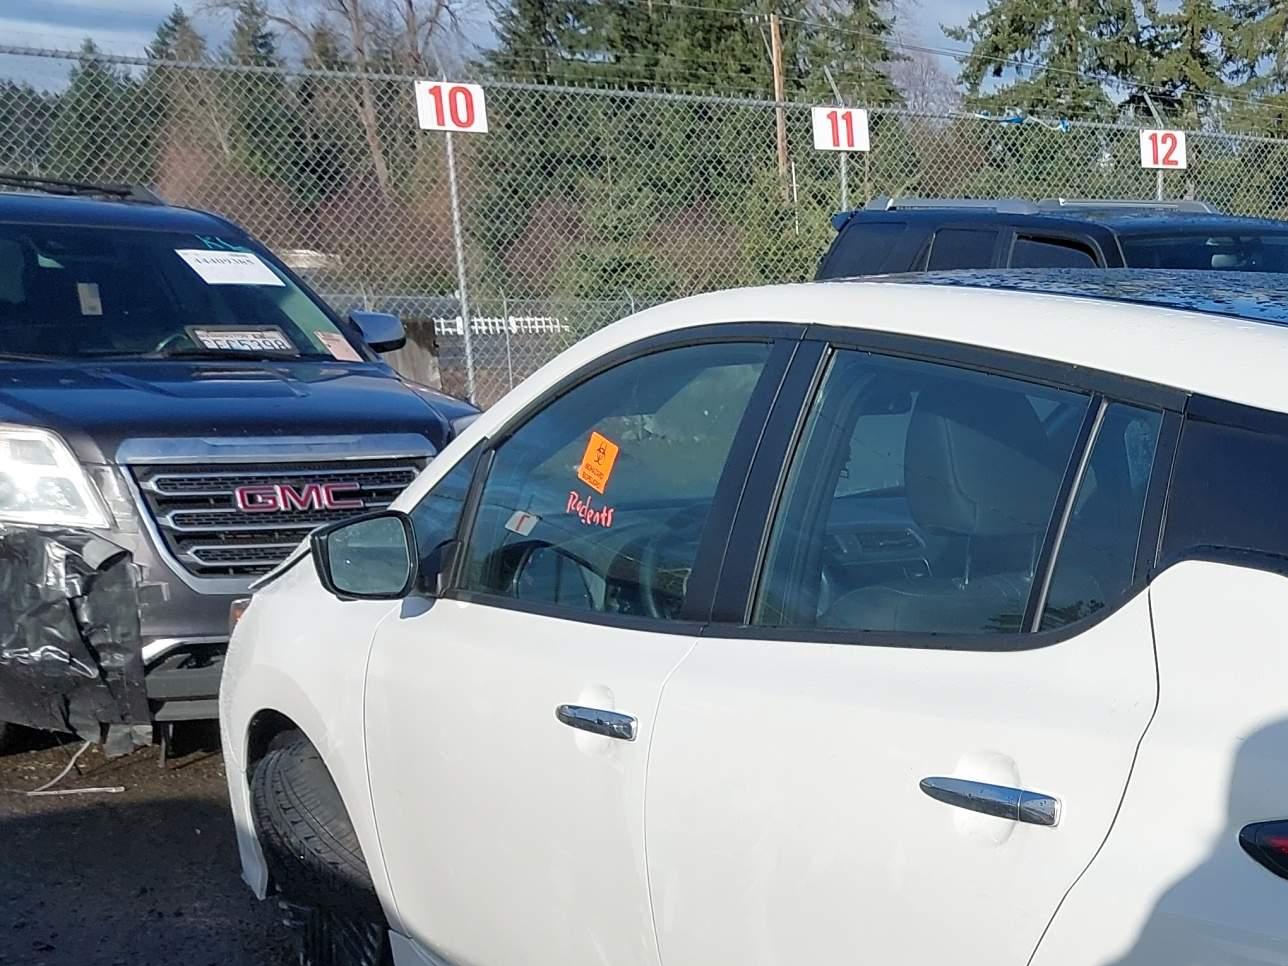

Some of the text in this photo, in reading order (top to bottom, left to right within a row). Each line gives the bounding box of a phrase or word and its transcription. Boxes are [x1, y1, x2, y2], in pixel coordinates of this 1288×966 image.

[428, 85, 476, 128] 10
[826, 111, 855, 148] 11
[1149, 132, 1180, 168] 12
[235, 482, 364, 513] GMC
